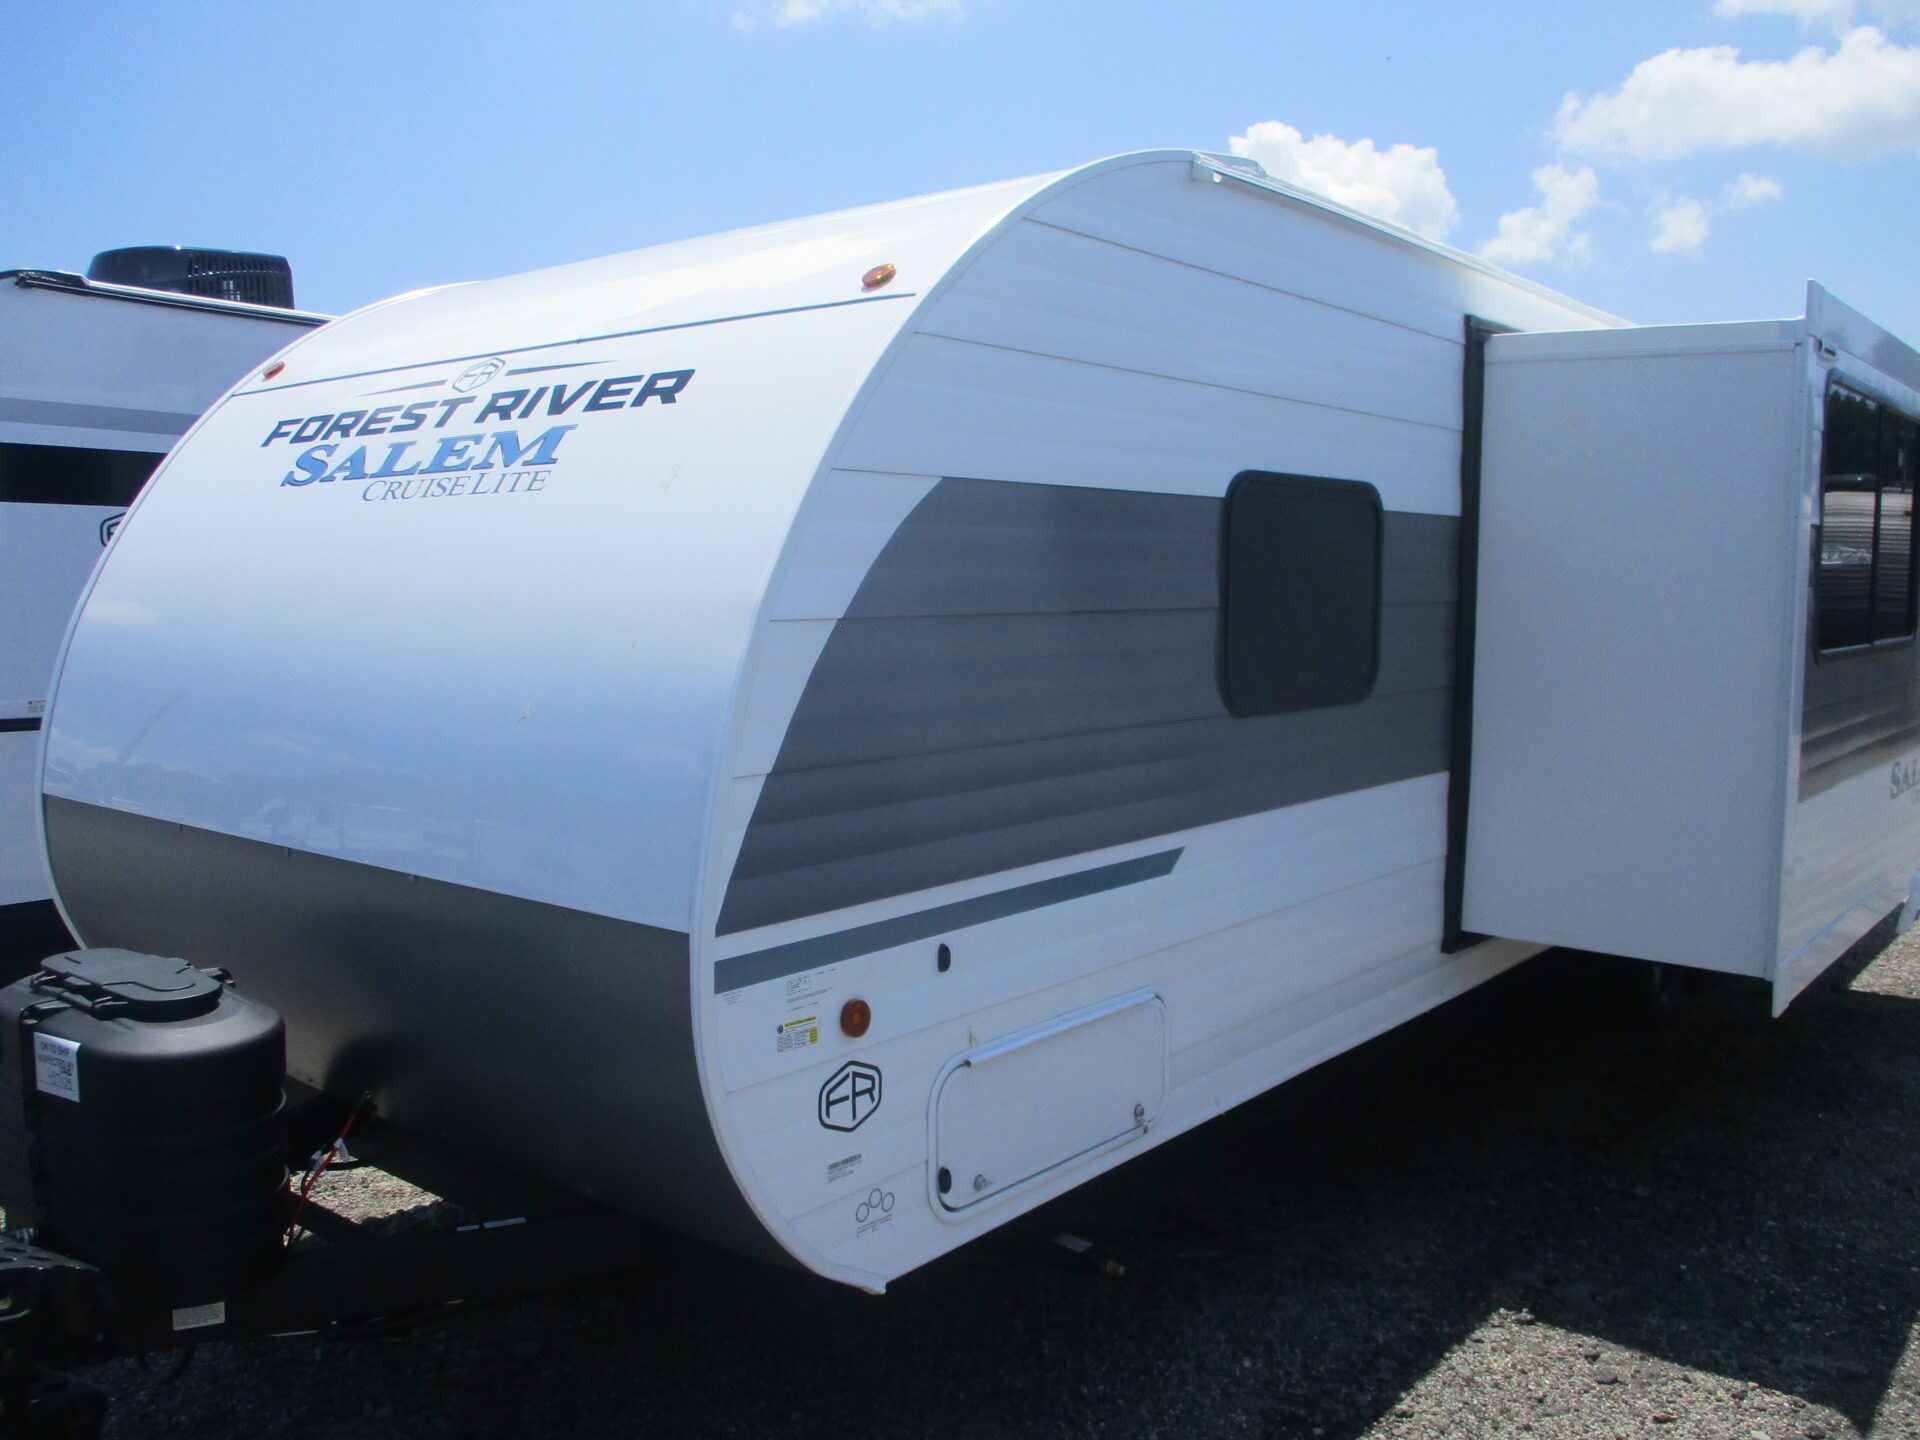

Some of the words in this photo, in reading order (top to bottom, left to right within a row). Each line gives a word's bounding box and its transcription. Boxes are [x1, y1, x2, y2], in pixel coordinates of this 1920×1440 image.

[261, 396, 477, 449] FOREST
[476, 369, 697, 424] RIVER
[280, 424, 581, 488] SALEM
[1889, 757, 1920, 800] SAL
[825, 1071, 876, 1121] FR
